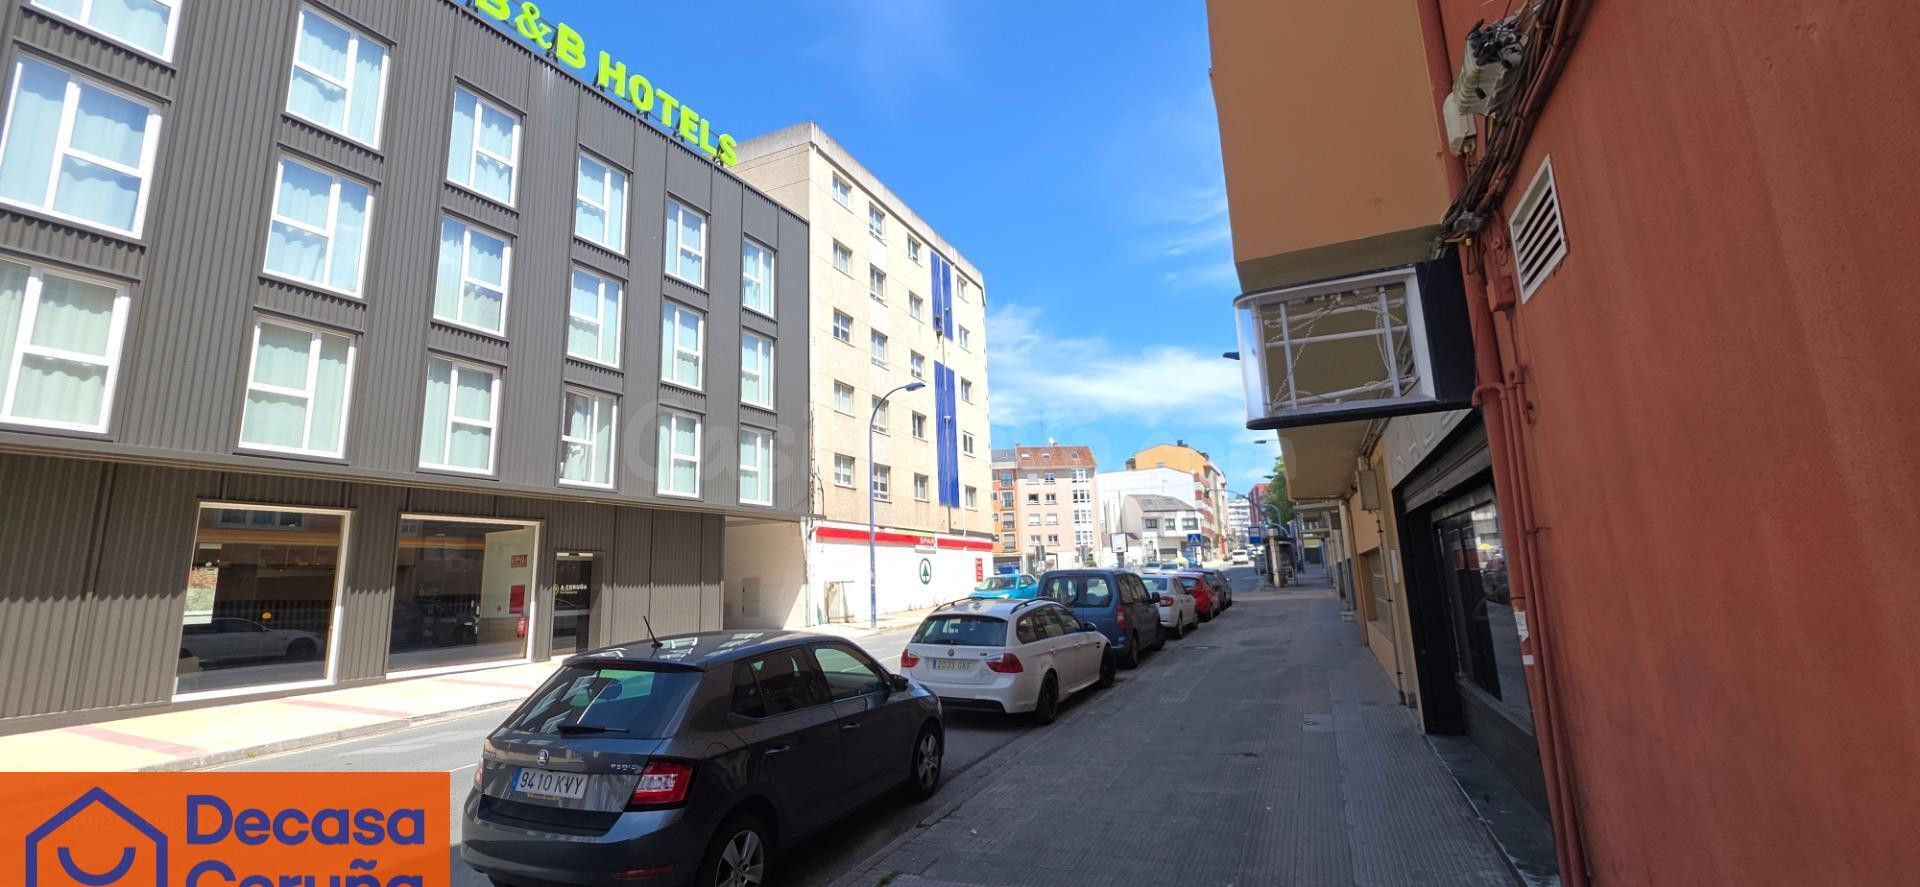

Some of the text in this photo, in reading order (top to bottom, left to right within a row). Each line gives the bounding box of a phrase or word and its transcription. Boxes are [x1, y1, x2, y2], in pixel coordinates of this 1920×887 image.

[597, 50, 738, 167] HOTELS
[520, 771, 584, 795] 9410 KVY
